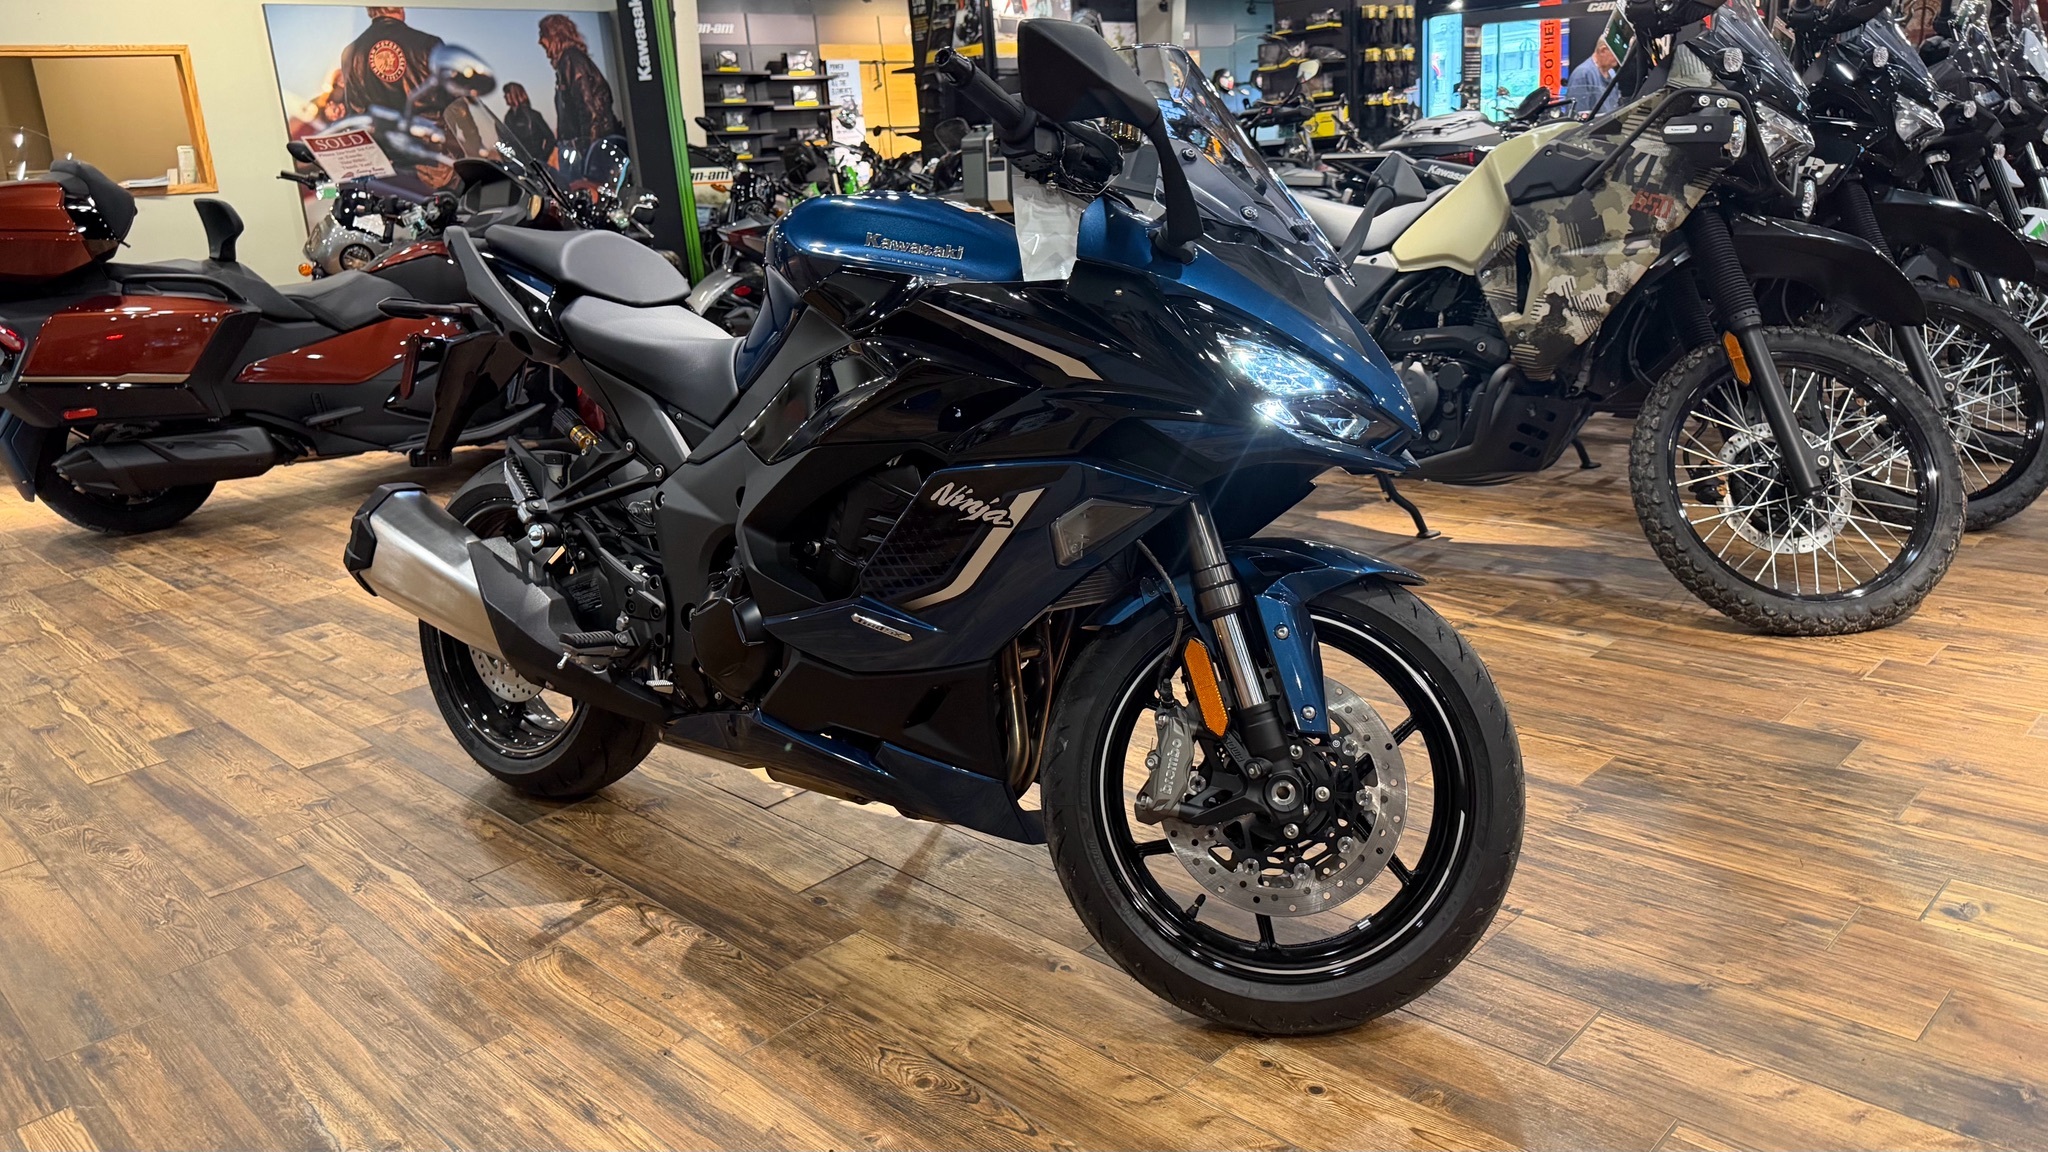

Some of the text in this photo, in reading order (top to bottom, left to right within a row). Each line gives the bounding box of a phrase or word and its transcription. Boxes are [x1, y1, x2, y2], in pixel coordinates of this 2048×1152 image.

[315, 133, 365, 151] SOLD
[1631, 187, 1675, 220] 650
[863, 231, 965, 261] Kawasaki
[930, 481, 1013, 526] Ninja
[1160, 738, 1182, 795] brembo
